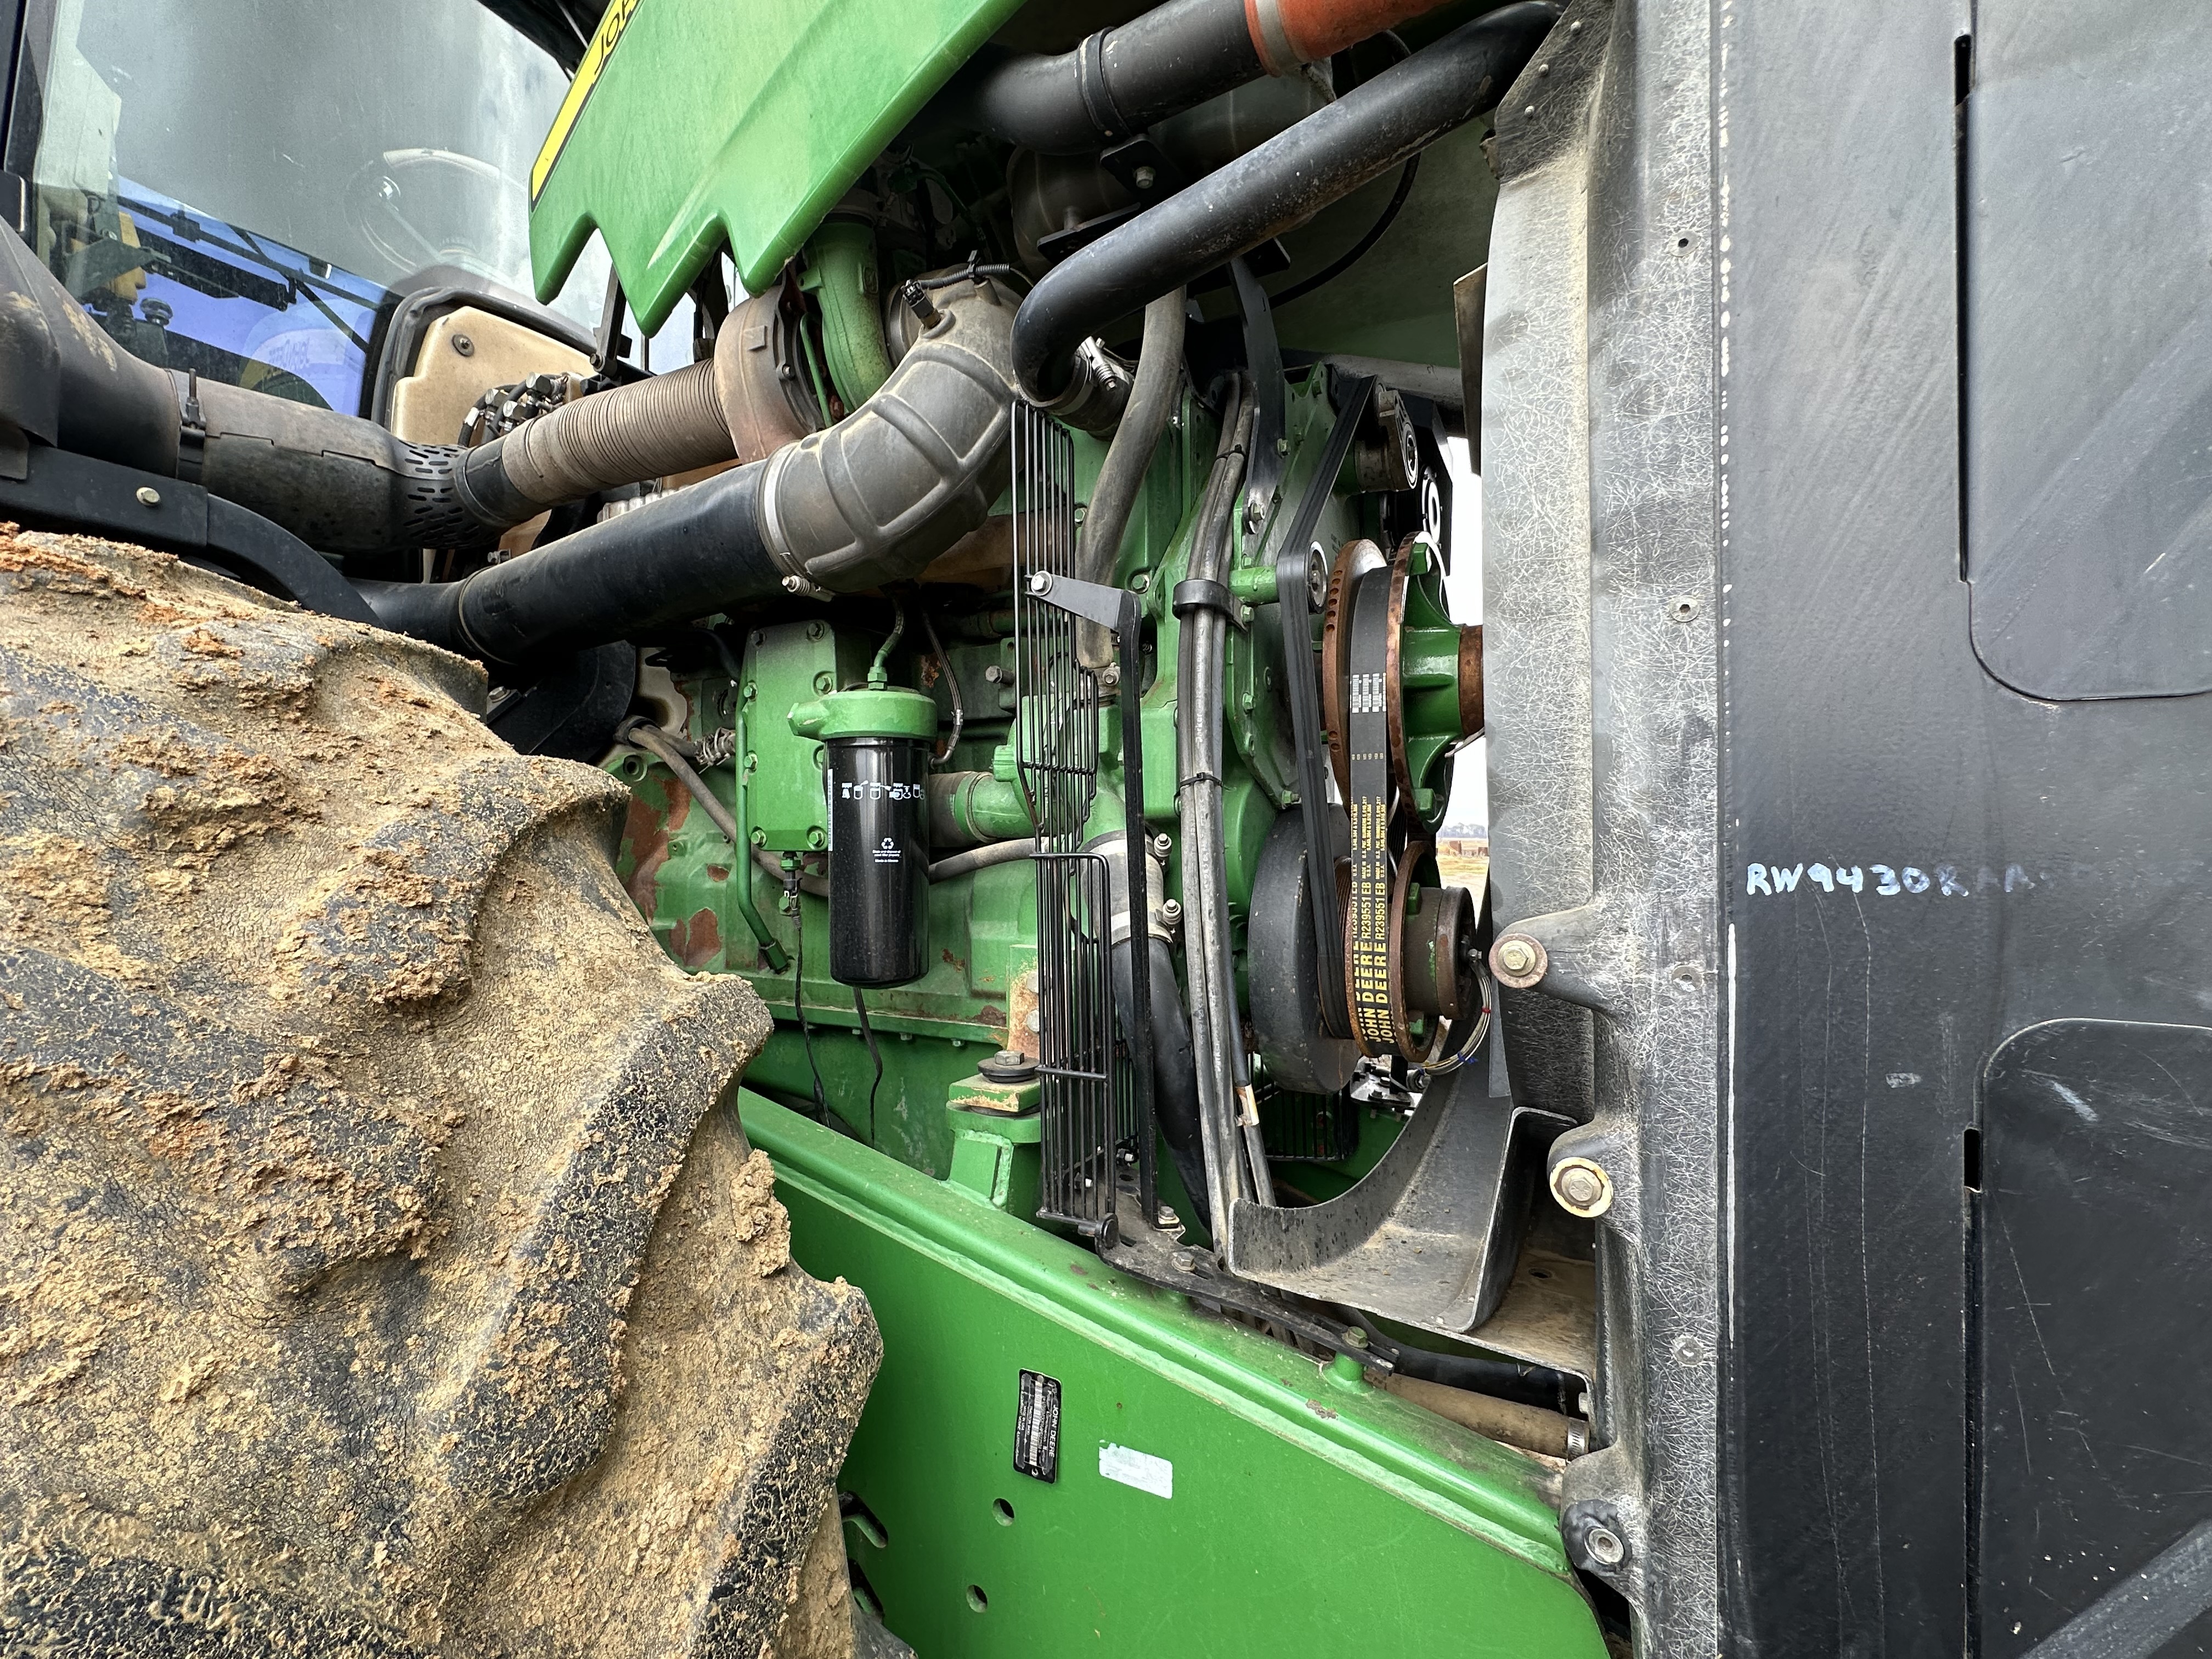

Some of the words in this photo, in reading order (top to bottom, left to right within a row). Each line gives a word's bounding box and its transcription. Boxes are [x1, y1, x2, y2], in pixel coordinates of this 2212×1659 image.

[1361, 882, 1372, 894] EB
[1375, 882, 1385, 895] EB
[1361, 896, 1372, 939] R239551
[1375, 897, 1385, 940] R239551
[1360, 941, 1374, 1002] DEERE
[1374, 942, 1388, 1004] DEERE
[1363, 1007, 1381, 1042] JOHN
[1376, 1009, 1395, 1043] JOHN
